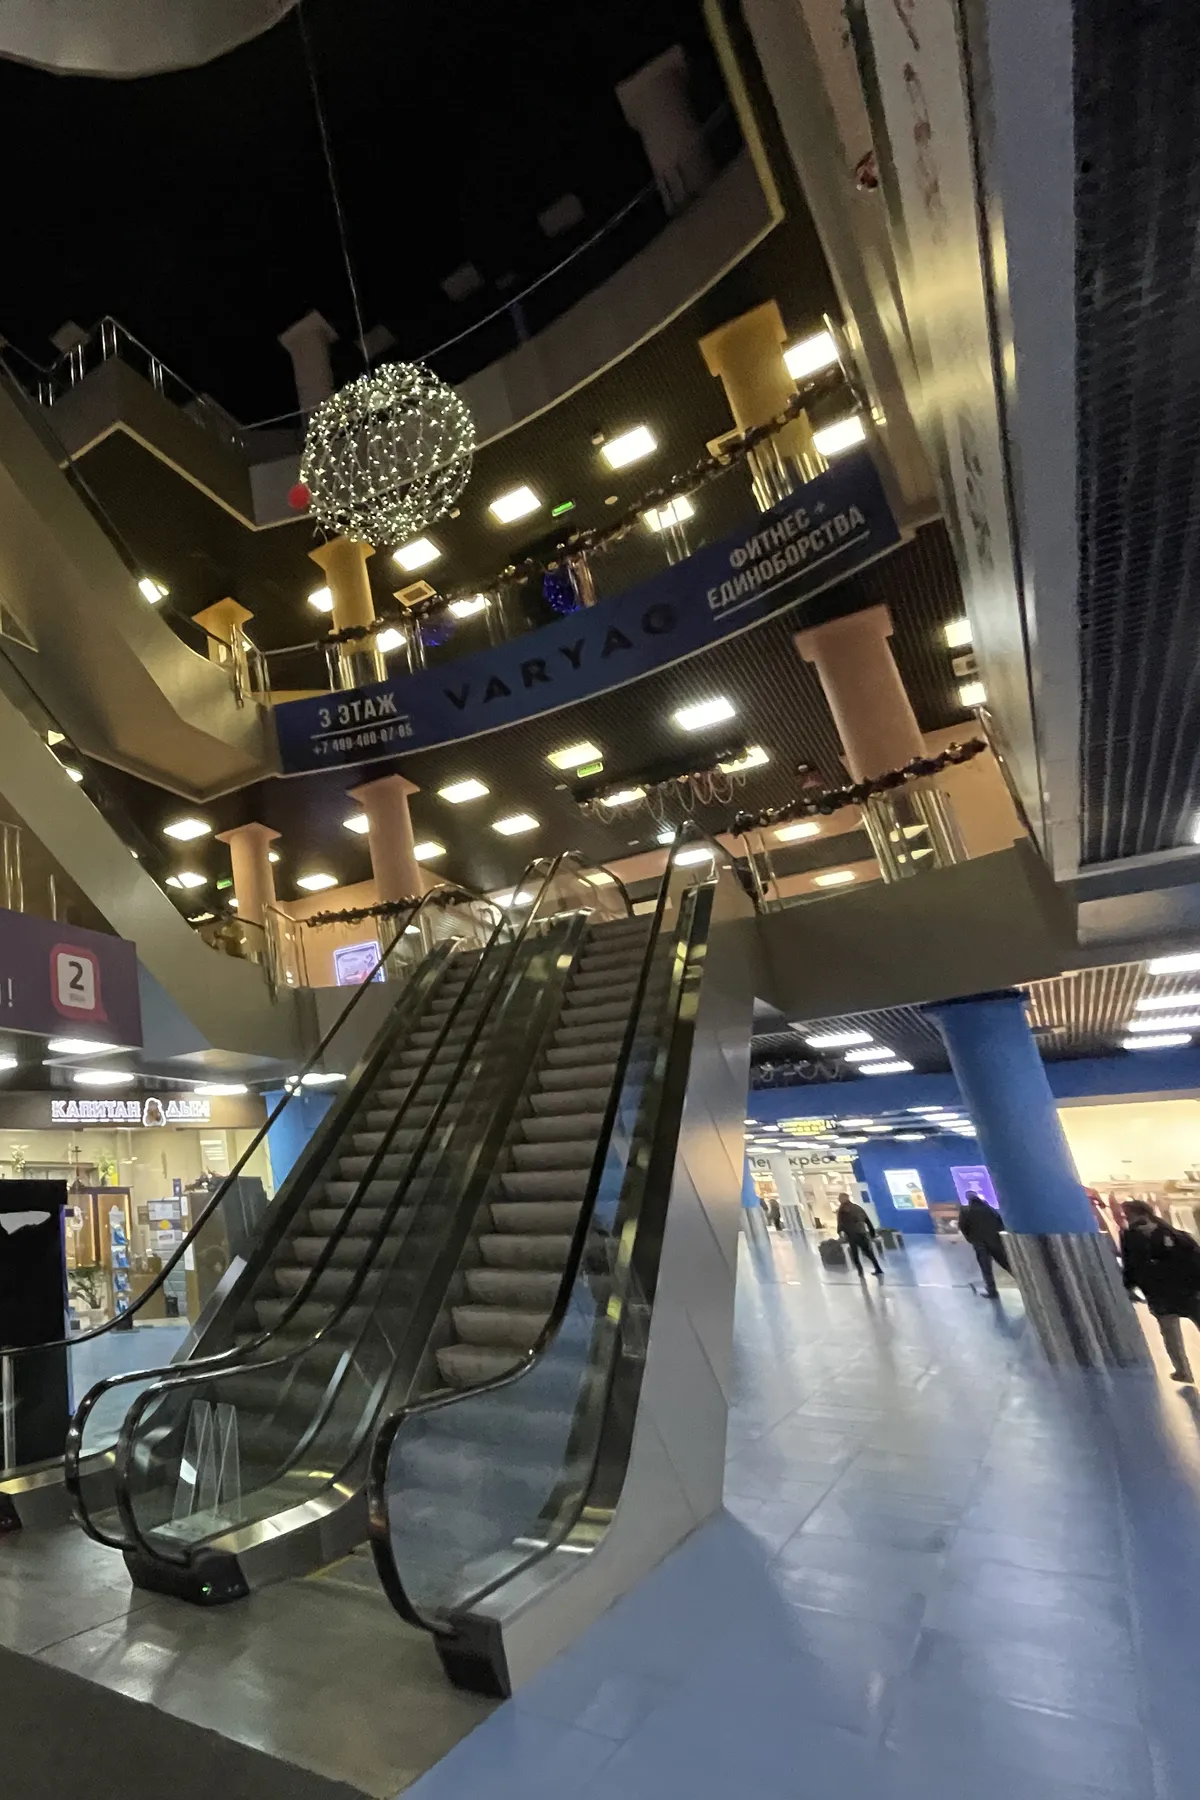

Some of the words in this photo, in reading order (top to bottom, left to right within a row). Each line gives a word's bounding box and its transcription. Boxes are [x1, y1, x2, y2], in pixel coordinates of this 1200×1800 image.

[729, 508, 811, 568] ФИТНЕС
[707, 504, 865, 610] ЕДИНОБОРСТВА
[318, 708, 332, 728] 3
[338, 692, 397, 725] ЭТАЖ
[68, 960, 85, 991] 2
[51, 1100, 141, 1118] КАПИТАН
